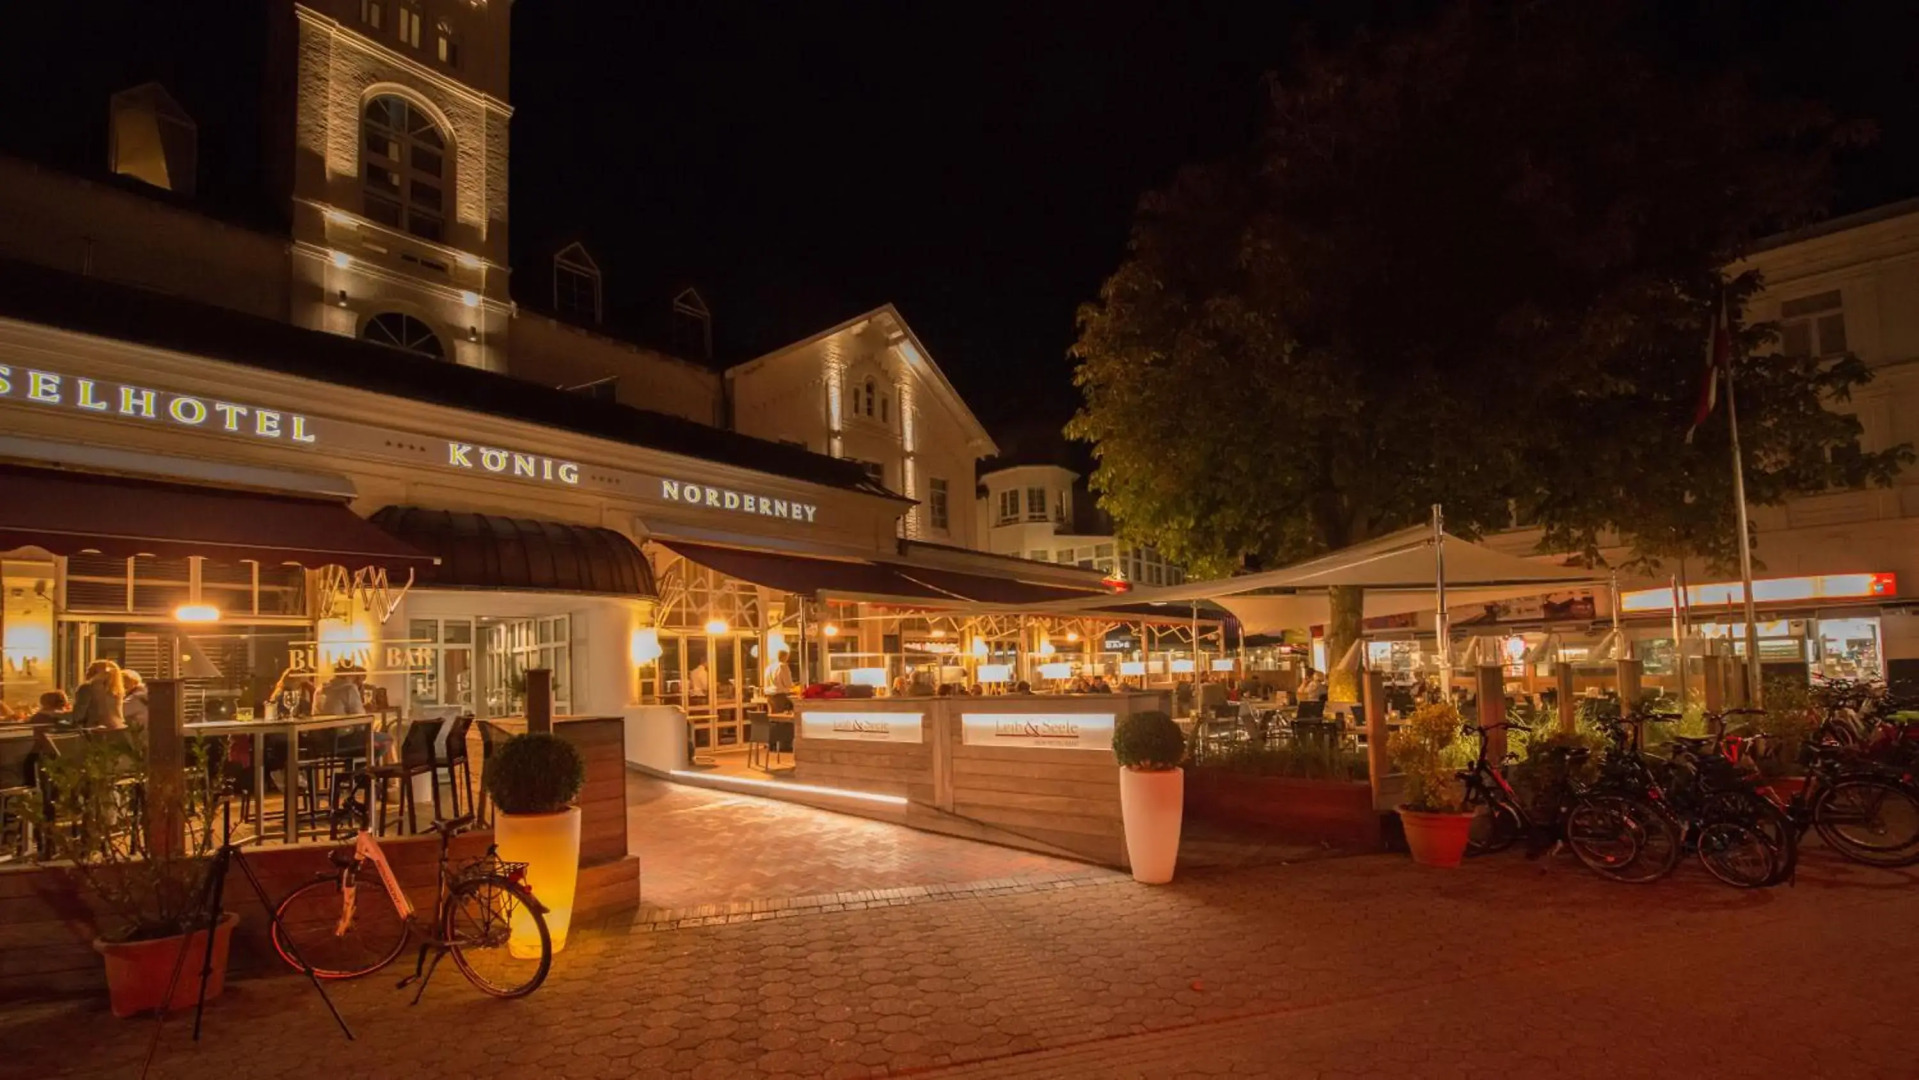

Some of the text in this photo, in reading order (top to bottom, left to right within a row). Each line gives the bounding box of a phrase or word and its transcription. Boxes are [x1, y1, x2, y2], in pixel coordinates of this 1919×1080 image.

[449, 441, 580, 485] KÖNIG
[661, 480, 817, 523] NORDERNEY
[385, 646, 432, 668] BAR
[995, 720, 1079, 737] Leib & Seele
